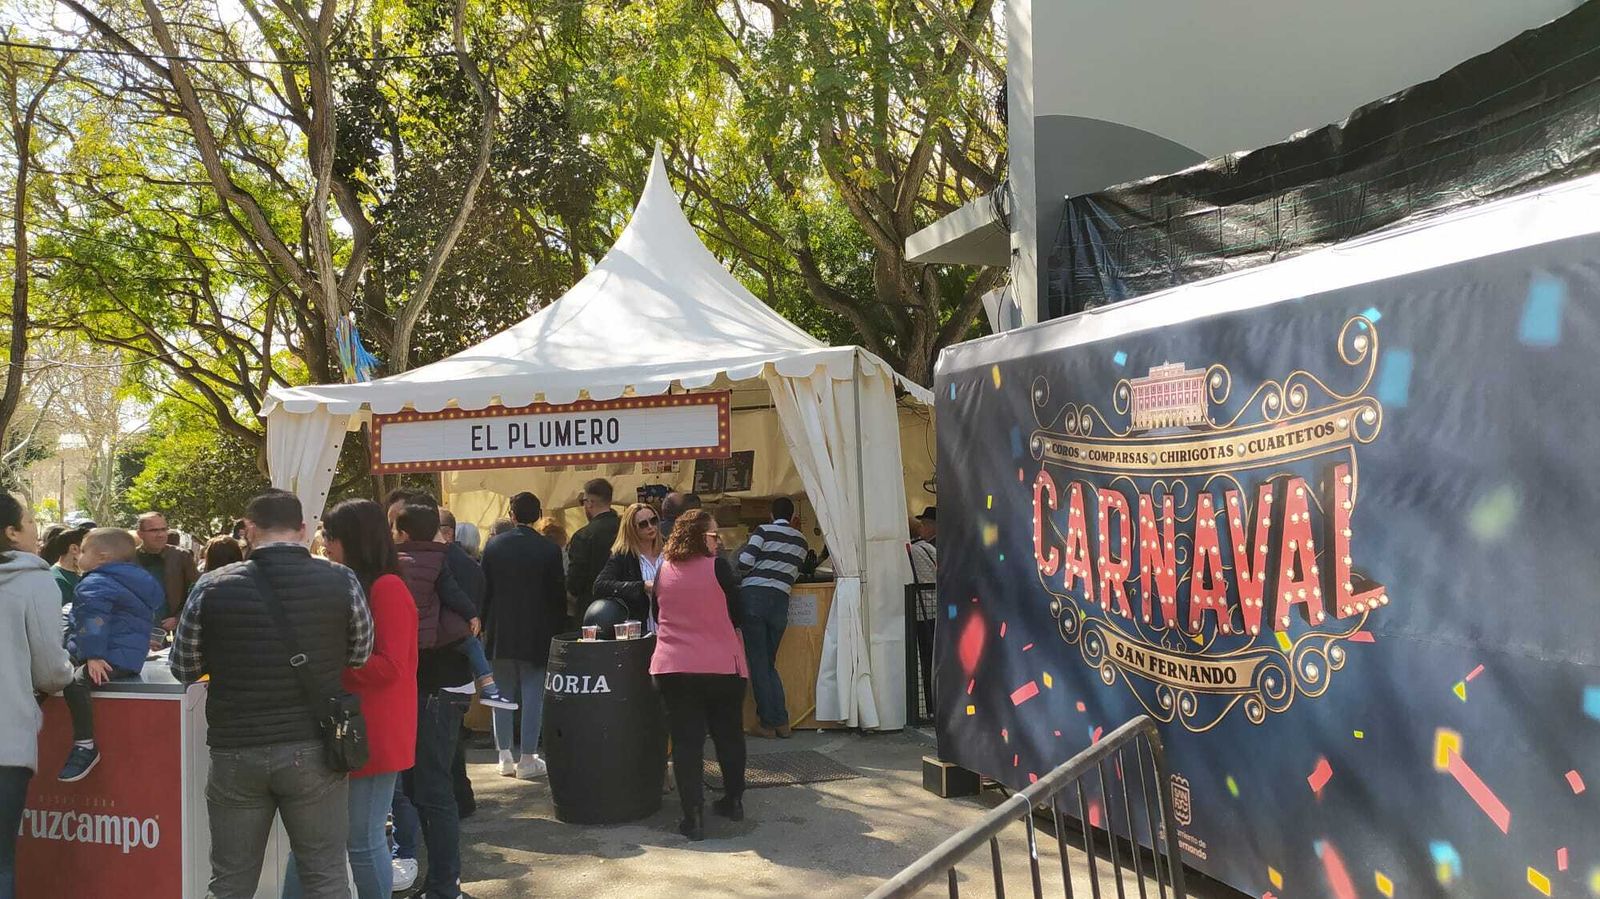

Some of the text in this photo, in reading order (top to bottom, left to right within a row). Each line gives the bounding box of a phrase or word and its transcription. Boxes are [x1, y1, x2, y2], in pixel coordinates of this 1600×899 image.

[471, 417, 620, 451] EL PLUMERO
[1052, 421, 1335, 464] COROS COMPARSAS CHIRIGOTAS CUARTETOS
[1032, 462, 1388, 636] CARNAVAL
[544, 671, 611, 694] LORIA
[1115, 642, 1237, 684] SAN FERNANDO
[18, 808, 160, 854] ruzcampo
